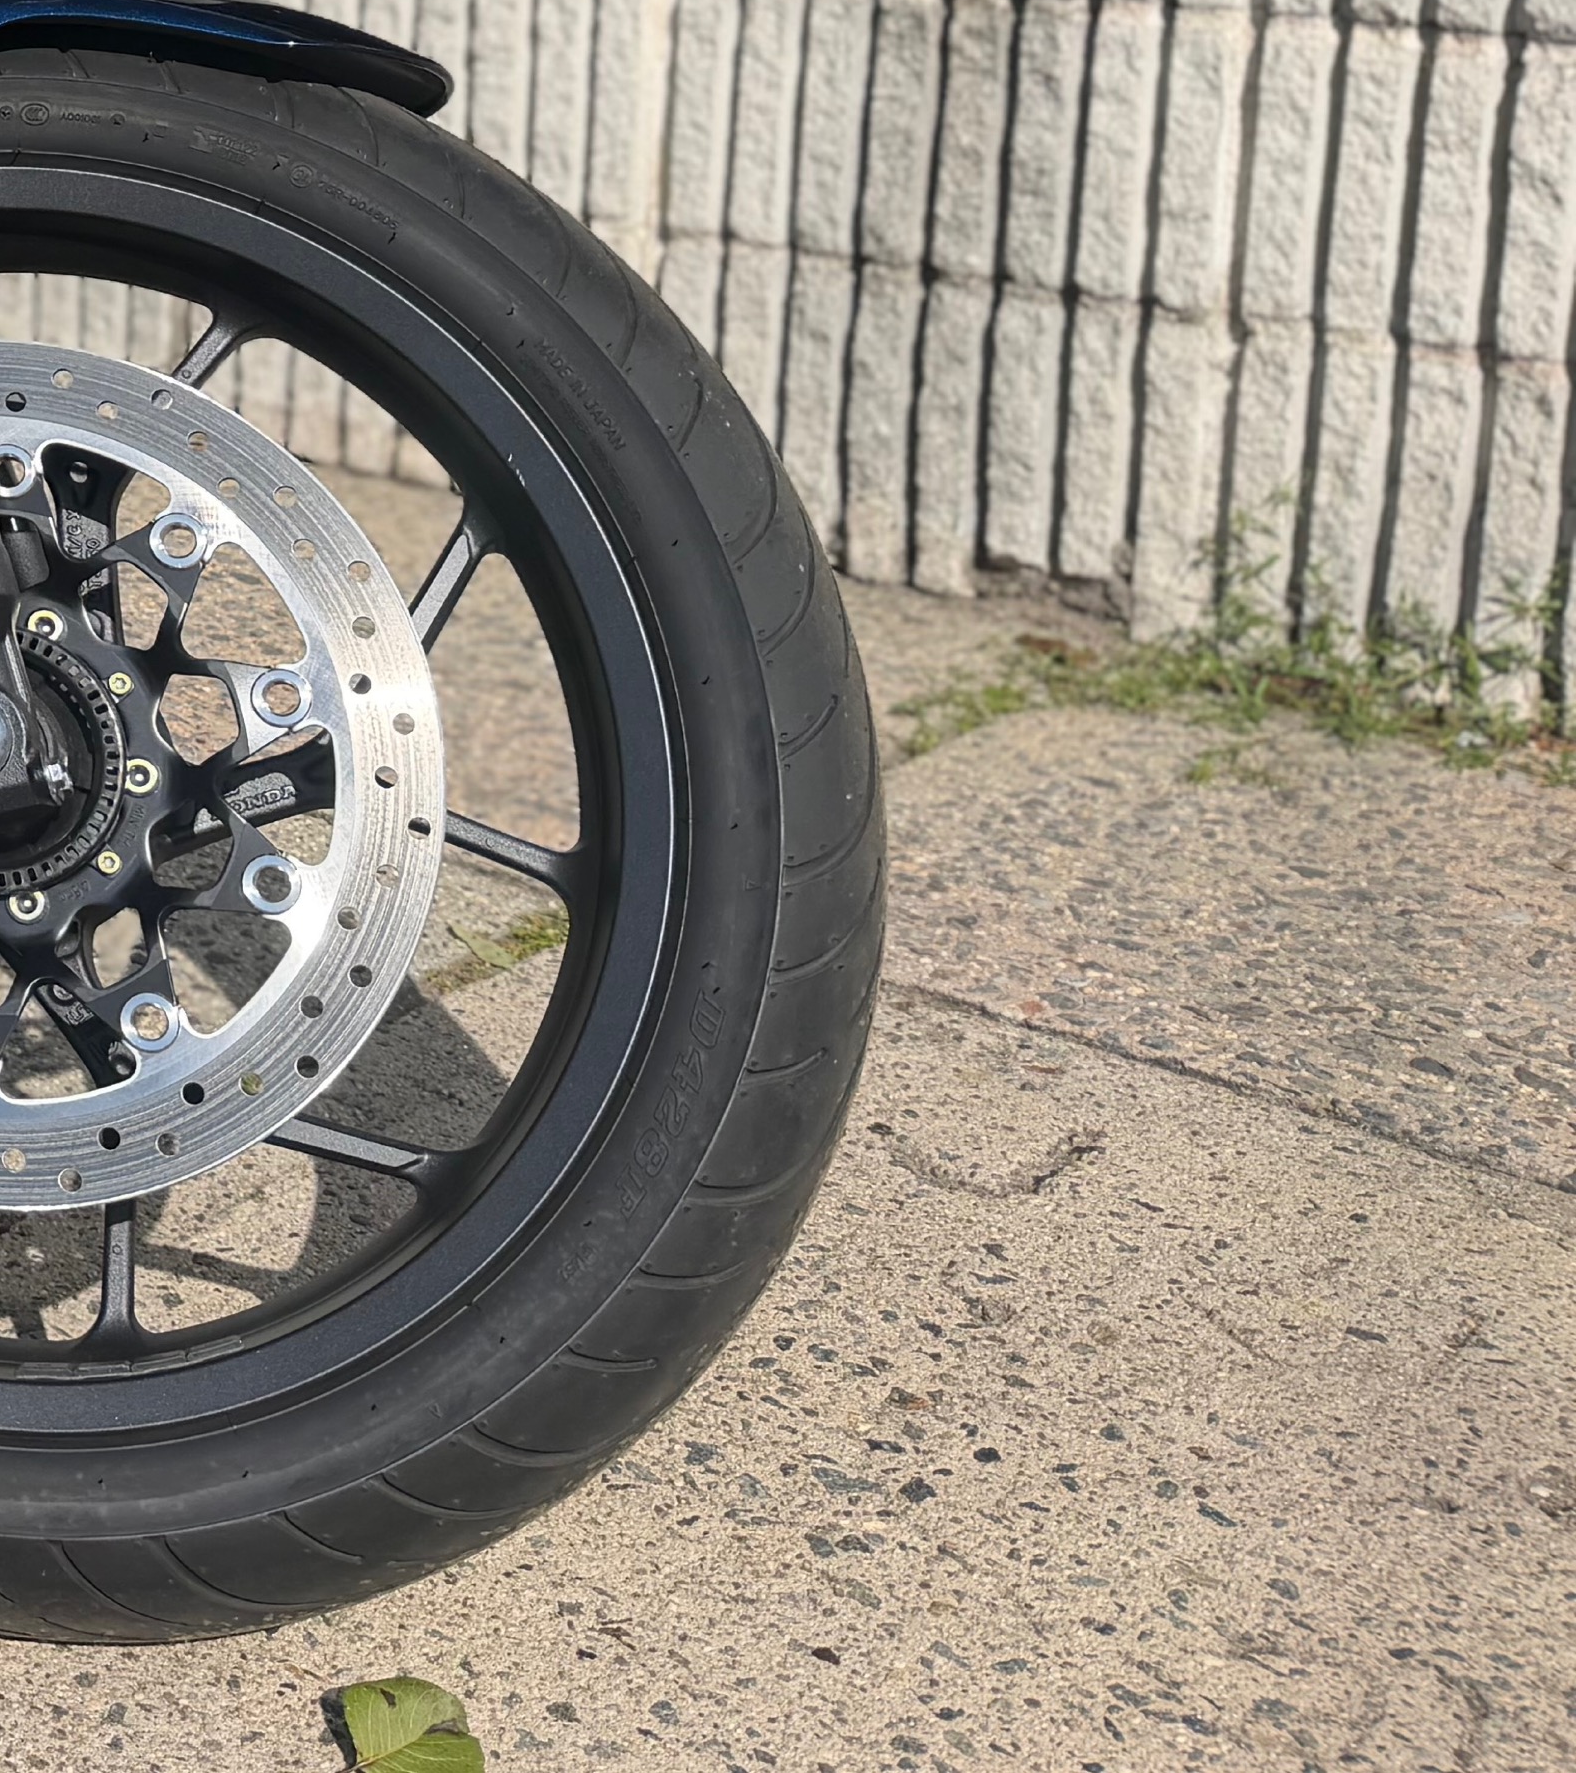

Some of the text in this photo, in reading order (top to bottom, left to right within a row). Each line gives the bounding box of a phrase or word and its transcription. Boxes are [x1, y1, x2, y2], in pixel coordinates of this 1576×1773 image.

[534, 337, 574, 379] MADE
[569, 379, 589, 398] IN
[583, 399, 627, 452] JAPAN
[228, 784, 298, 816] ONDA
[615, 989, 726, 1223] D428F
